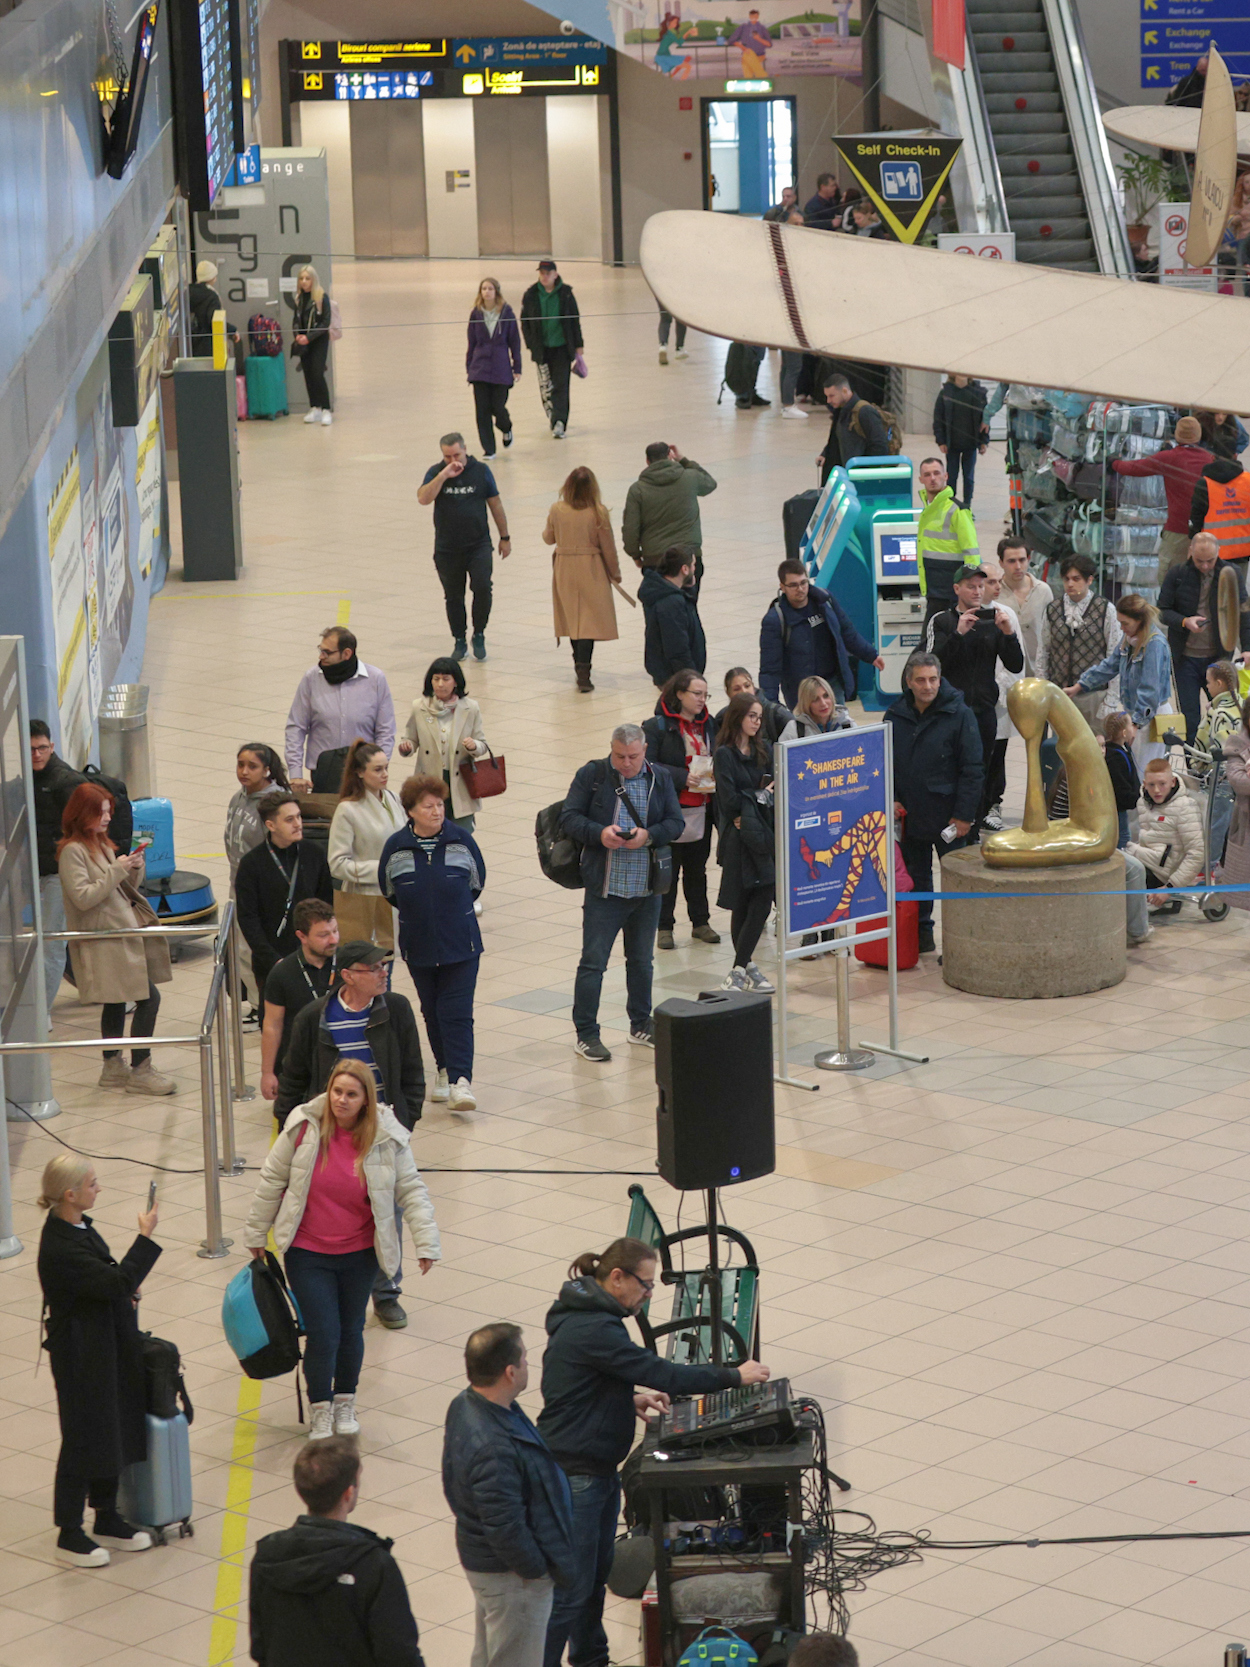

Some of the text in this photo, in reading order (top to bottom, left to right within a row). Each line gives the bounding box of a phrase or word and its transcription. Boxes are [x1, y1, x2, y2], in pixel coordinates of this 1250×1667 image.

[1166, 28, 1211, 38] Exchange
[526, 42, 537, 50] de
[1169, 42, 1203, 50] Exchange
[1170, 61, 1191, 71] Tren
[857, 144, 941, 156] Self Check-In
[262, 162, 304, 176] ange
[812, 754, 865, 774] SHAKESPEARE
[819, 772, 859, 790] IN THE AIR
[138, 824, 160, 832] MODEL
